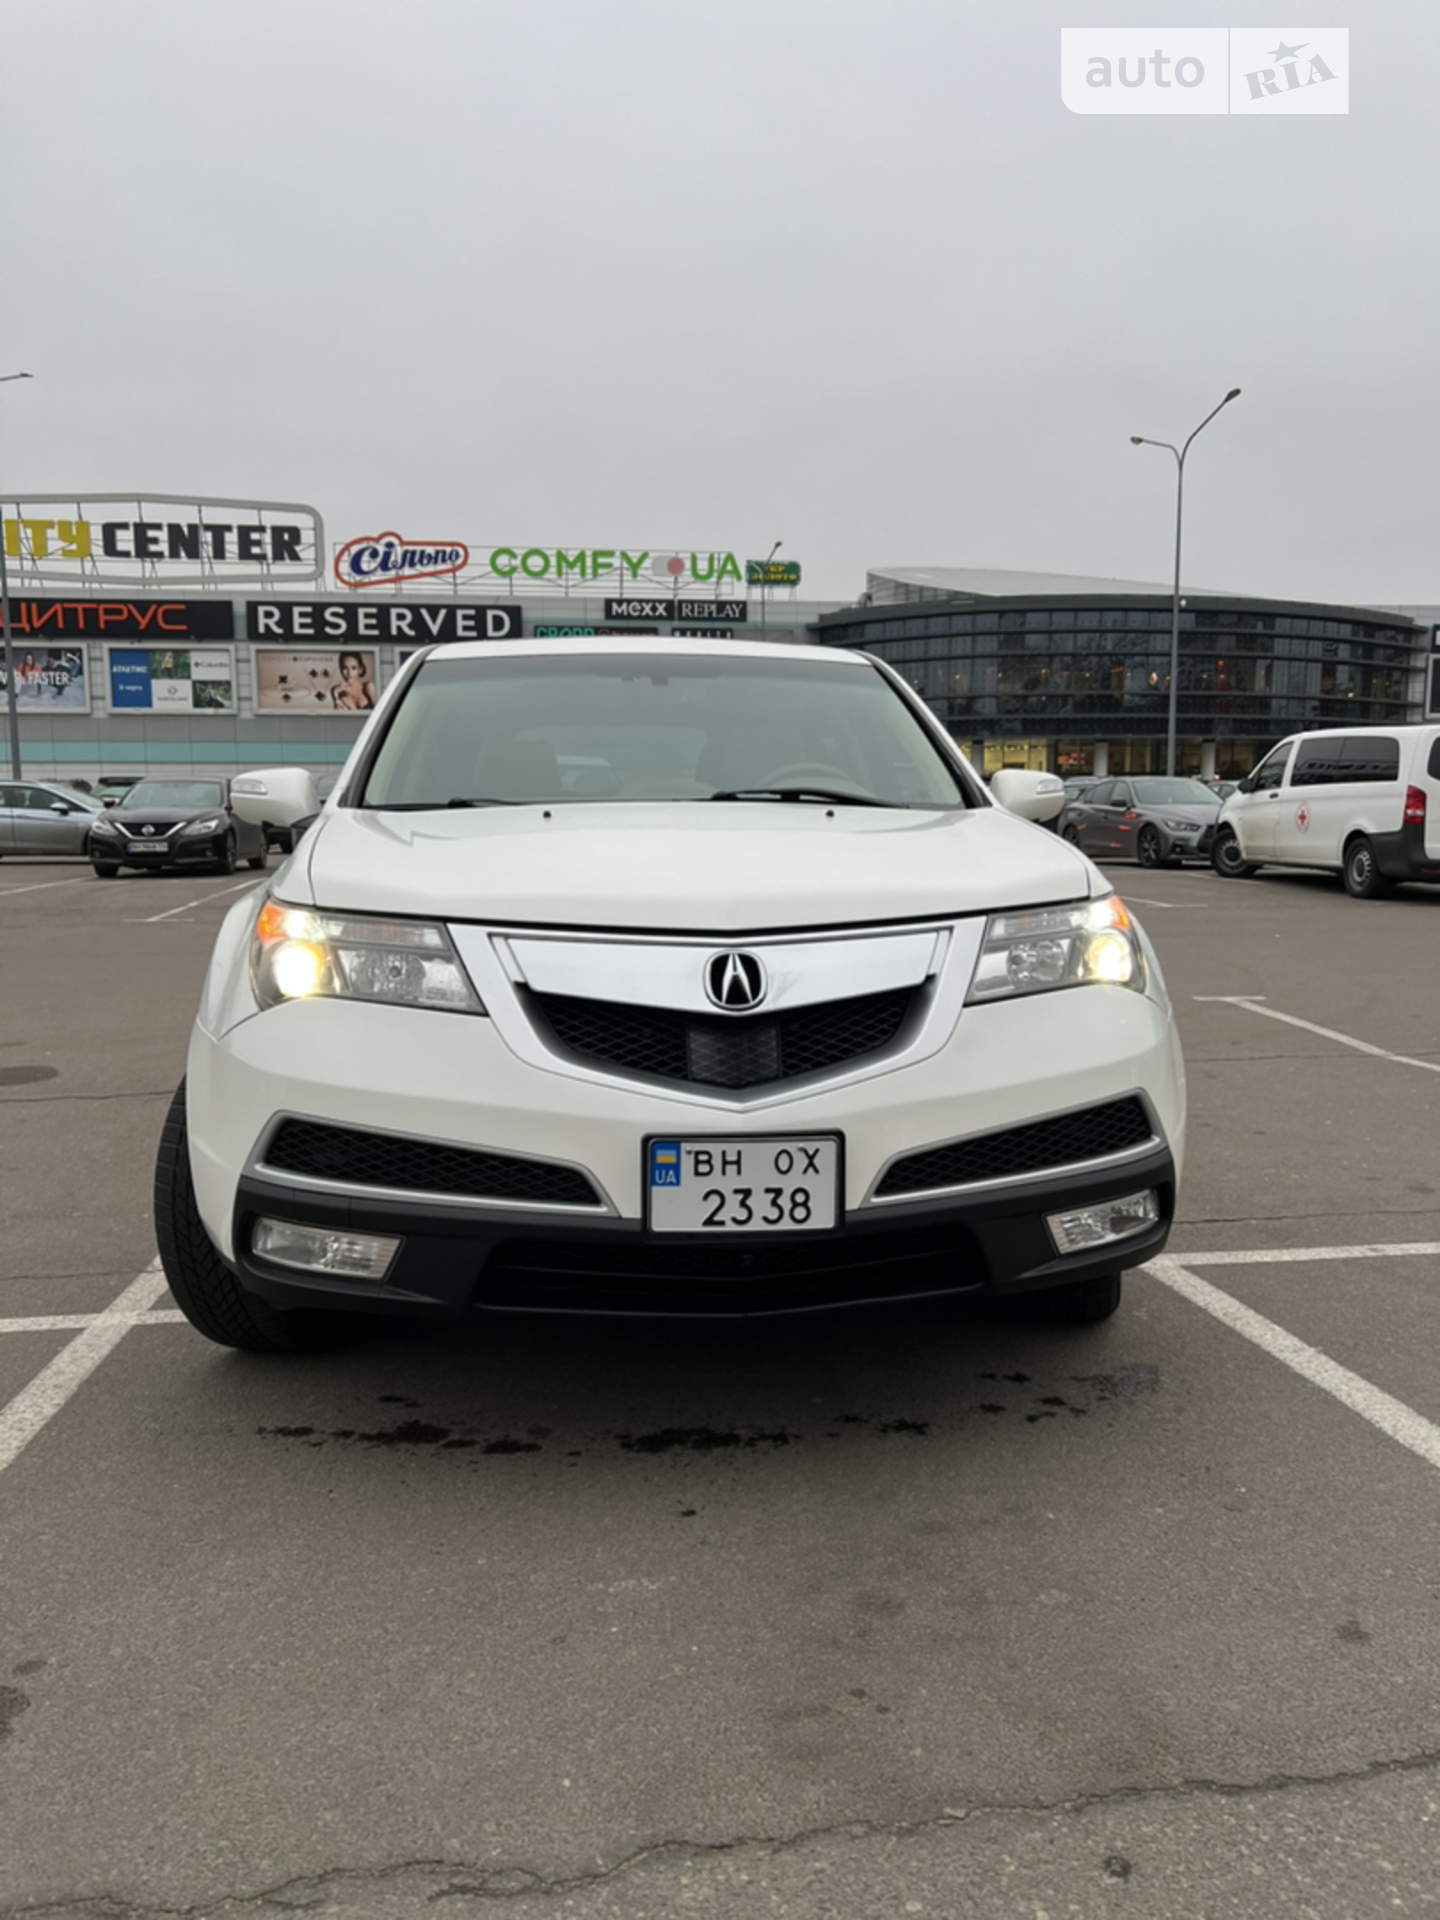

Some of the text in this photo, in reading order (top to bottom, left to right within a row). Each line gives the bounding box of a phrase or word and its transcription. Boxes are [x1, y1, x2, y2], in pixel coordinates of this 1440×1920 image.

[102, 522, 303, 562] CENTER
[350, 541, 462, 576] Сільпо
[489, 547, 743, 582] COMFY UA
[257, 605, 511, 638] RESERVED
[681, 603, 743, 619] REPLAY
[655, 1170, 677, 1184] UA
[693, 1149, 742, 1177] BH
[701, 1186, 812, 1227] 2338
